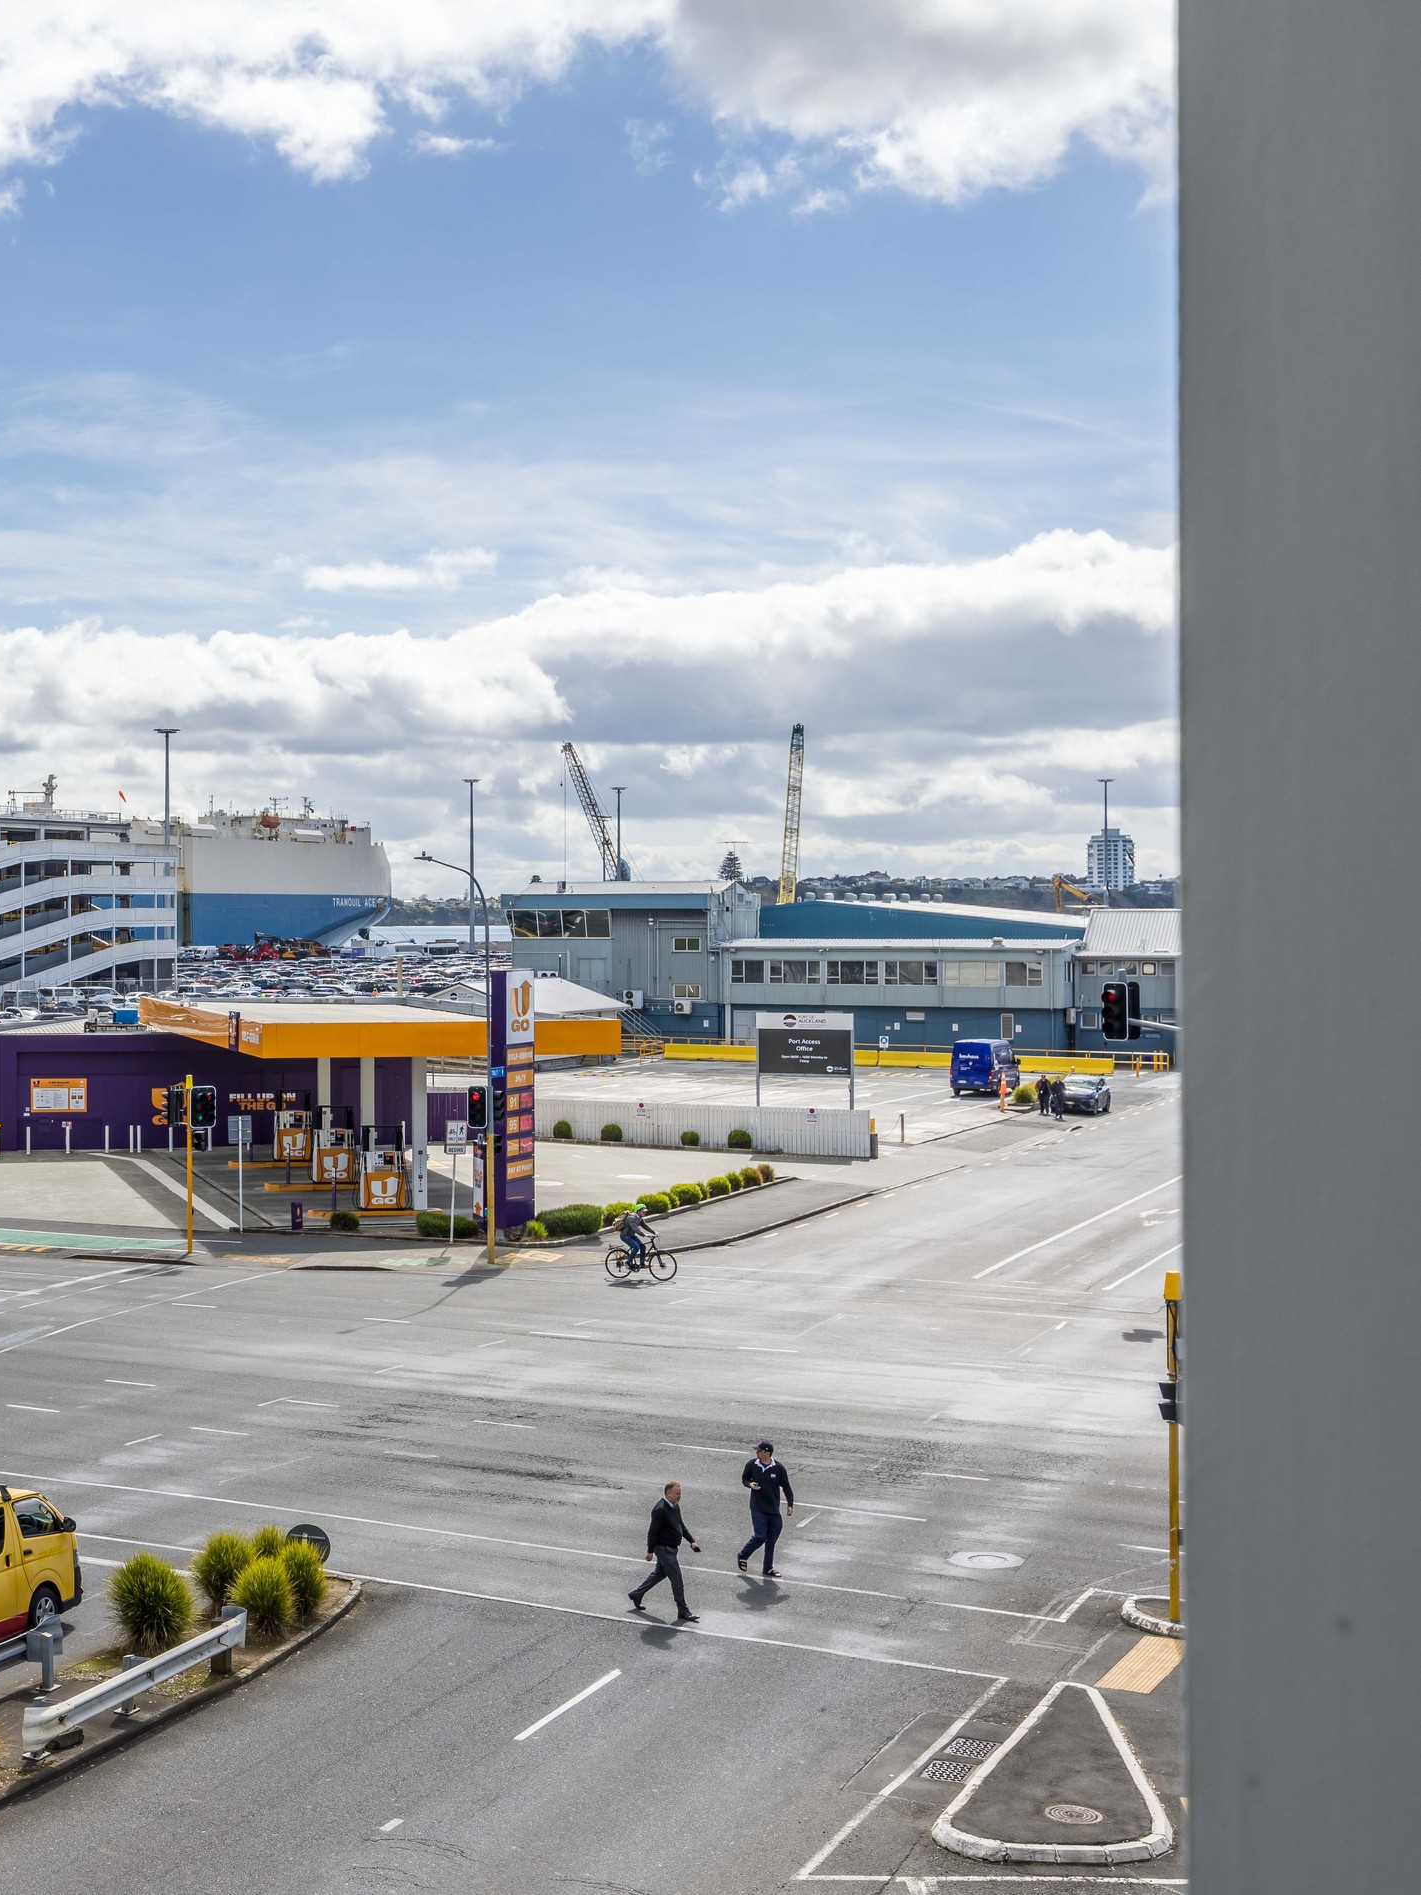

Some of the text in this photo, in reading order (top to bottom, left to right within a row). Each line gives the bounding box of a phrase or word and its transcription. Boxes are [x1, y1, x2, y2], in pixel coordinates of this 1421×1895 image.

[332, 897, 376, 907] TRANQUIL ACE
[511, 1018, 530, 1032] GO
[229, 1093, 255, 1103] FILL
[256, 1093, 275, 1102] UP
[509, 1097, 518, 1108] 91
[238, 1102, 265, 1111] THE
[509, 1119, 518, 1131] 95
[507, 1166, 516, 1174] PAY
[371, 1196, 397, 1205] GO
